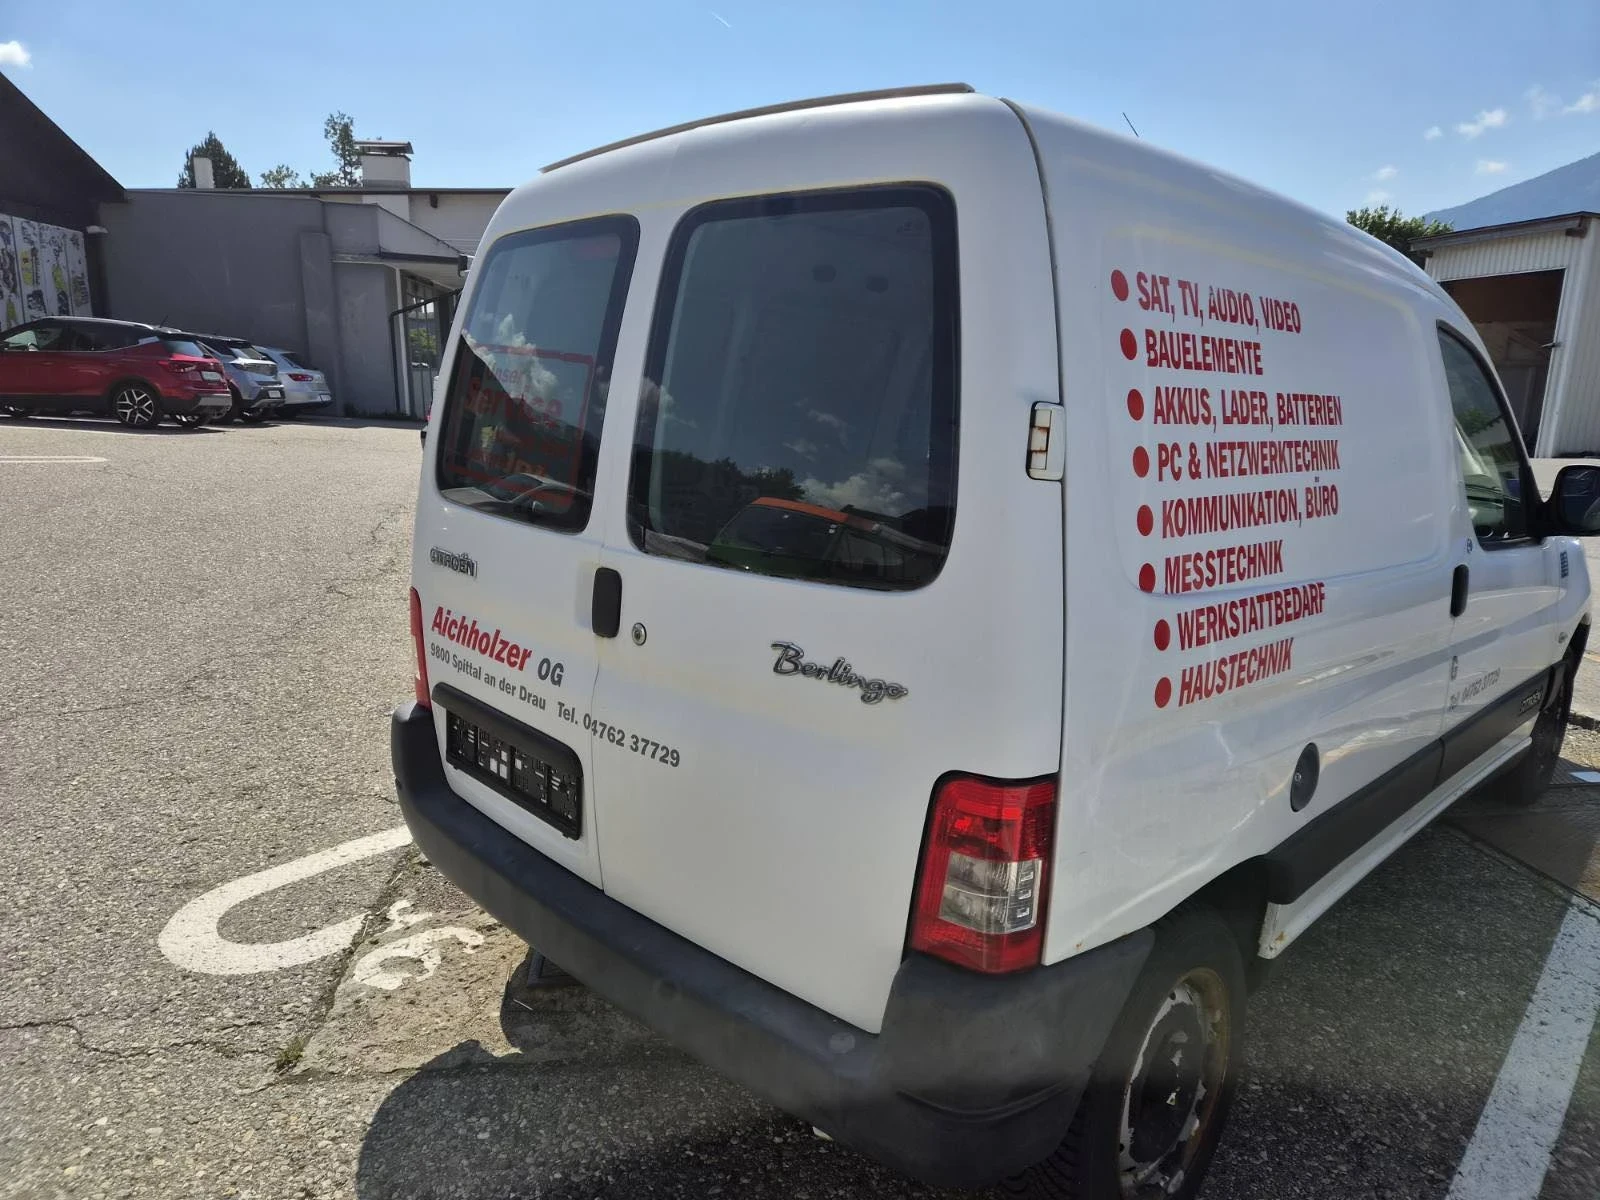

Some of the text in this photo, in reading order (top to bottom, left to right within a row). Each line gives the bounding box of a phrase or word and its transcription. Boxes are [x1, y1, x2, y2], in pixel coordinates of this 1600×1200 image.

[1136, 271, 1302, 335] SAT, TV, AUDIO, VIDEO
[1145, 328, 1263, 376] BAUELEMENTE
[1153, 386, 1343, 433] AKKUS, LADER, BATTERIEN
[1157, 439, 1341, 482] PC & NETZWERKTECHNIK
[1162, 476, 1339, 539] KOMMUNIKATION, BÜRO
[1164, 539, 1284, 595] MESSTECHNIK
[431, 606, 565, 688] Aichholzer OG
[1177, 582, 1326, 651] WERKSTATTBEDARF
[770, 640, 909, 705] Berlingo
[1178, 637, 1295, 708] HAUSTECHNIK
[430, 642, 681, 768] 9800 Spittal an der Drau Tel. 04762 37729
